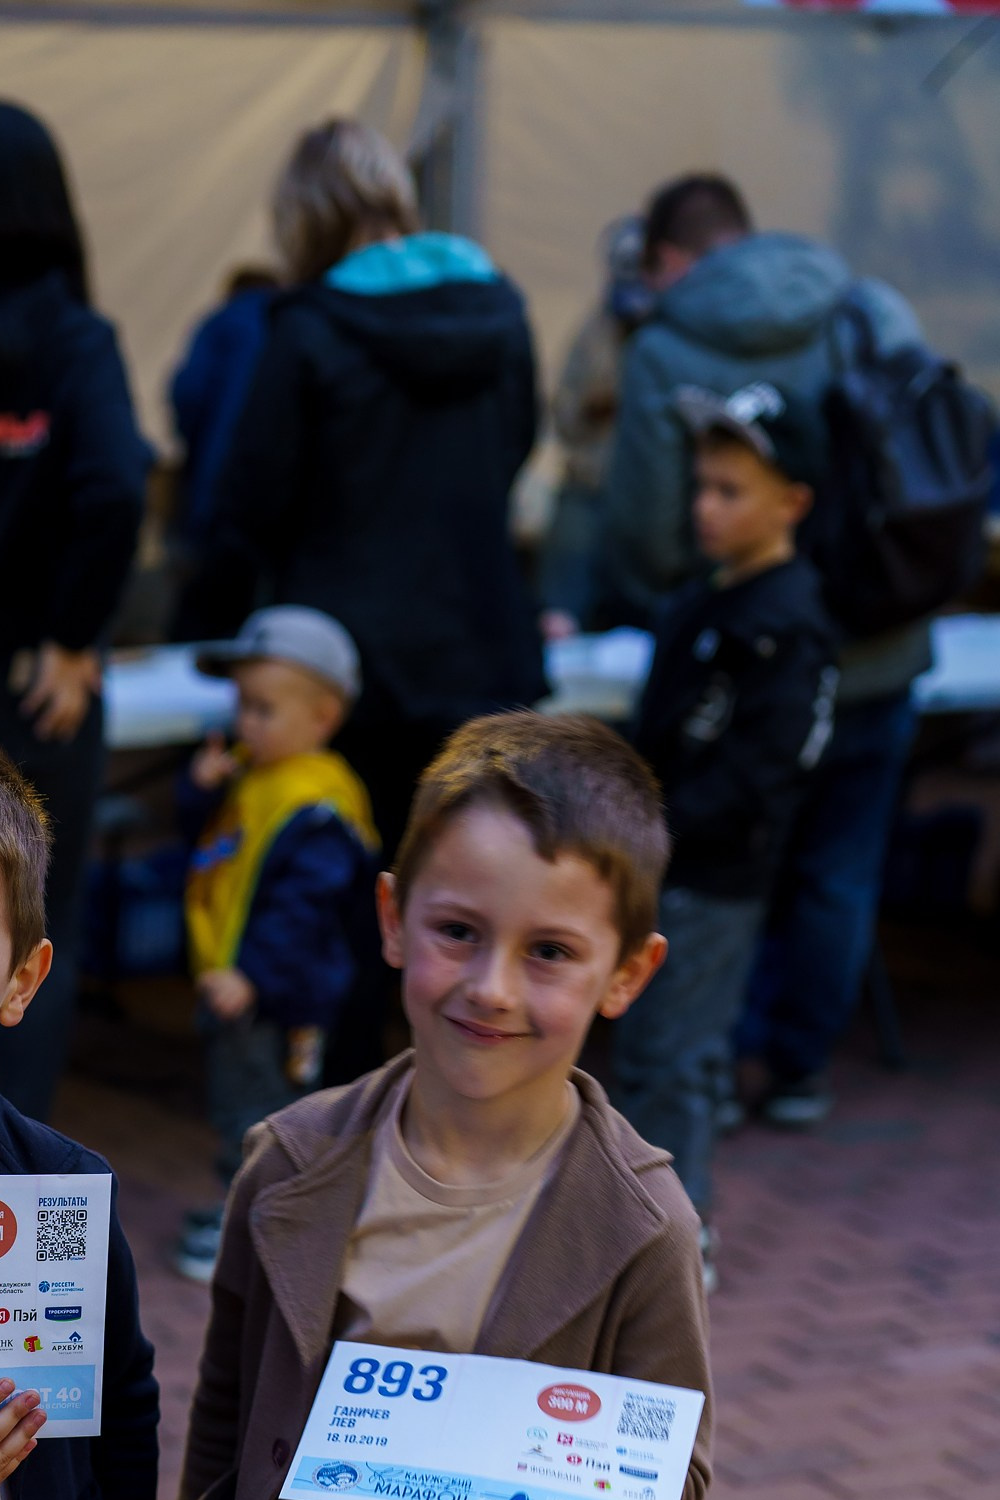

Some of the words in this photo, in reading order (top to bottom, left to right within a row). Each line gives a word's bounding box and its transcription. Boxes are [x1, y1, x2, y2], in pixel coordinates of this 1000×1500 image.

[38, 1197, 88, 1207] РЕЗУЛЬТАТЫ
[13, 1309, 38, 1322] Пэй
[343, 1357, 448, 1402] 893
[56, 1387, 82, 1402] 40
[333, 1405, 391, 1420] ГАНИЧЕВ
[329, 1416, 357, 1428] ЛЕВ
[405, 1471, 473, 1490] КАЛУЖСКИЙ
